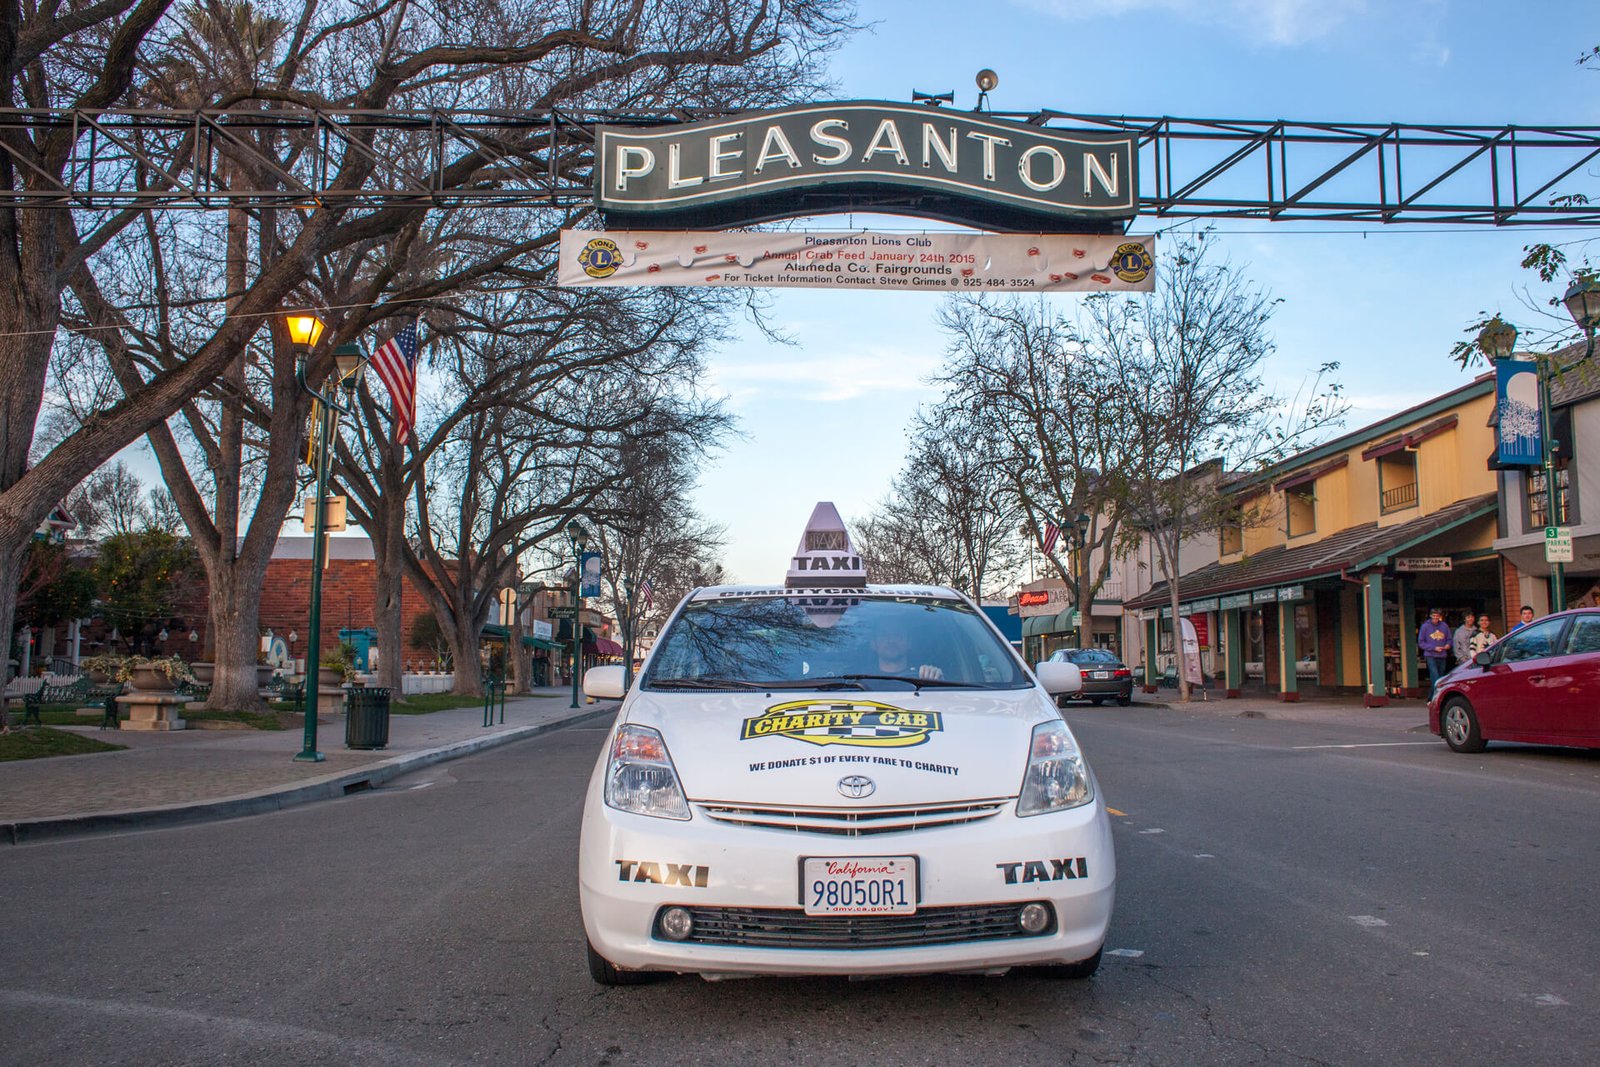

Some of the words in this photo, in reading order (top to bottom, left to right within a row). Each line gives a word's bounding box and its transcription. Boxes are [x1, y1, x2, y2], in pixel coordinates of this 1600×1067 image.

[615, 118, 1118, 197] PLEASANTON
[590, 240, 614, 249] LIONS
[805, 236, 867, 246] Pleasanton
[872, 236, 901, 246] Lions
[906, 237, 932, 247] Club
[763, 250, 801, 260] Annual
[806, 250, 833, 260] Crab
[837, 250, 865, 260] Feed
[870, 251, 915, 264] January
[920, 253, 945, 263] 24th
[949, 253, 975, 264] 2015
[784, 262, 842, 272] Alameda
[847, 263, 870, 273] Co.
[876, 263, 953, 278] Fairgrounds
[724, 273, 739, 282] For
[744, 273, 774, 282] Ticket
[777, 273, 832, 283] Information
[836, 275, 876, 285] Contact
[880, 276, 908, 286] Steve
[912, 276, 947, 287] Grimes
[950, 277, 960, 287] @
[963, 278, 1035, 288] 925-484-3524
[1549, 528, 1555, 538] 3
[793, 557, 860, 571] TAXI
[754, 711, 865, 734] CHARITY
[879, 711, 929, 727] CAB
[749, 761, 766, 772] WE
[768, 758, 808, 770] DONATE
[809, 756, 822, 765] $1
[824, 755, 837, 764] OF
[839, 755, 871, 763] EVERY
[872, 756, 898, 766] FARE
[899, 759, 913, 769] TO
[915, 761, 960, 776] CHARITY
[615, 859, 710, 888] TAXI
[828, 861, 895, 879] California
[995, 857, 1088, 885] TAXI
[812, 879, 909, 907] 98050R1
